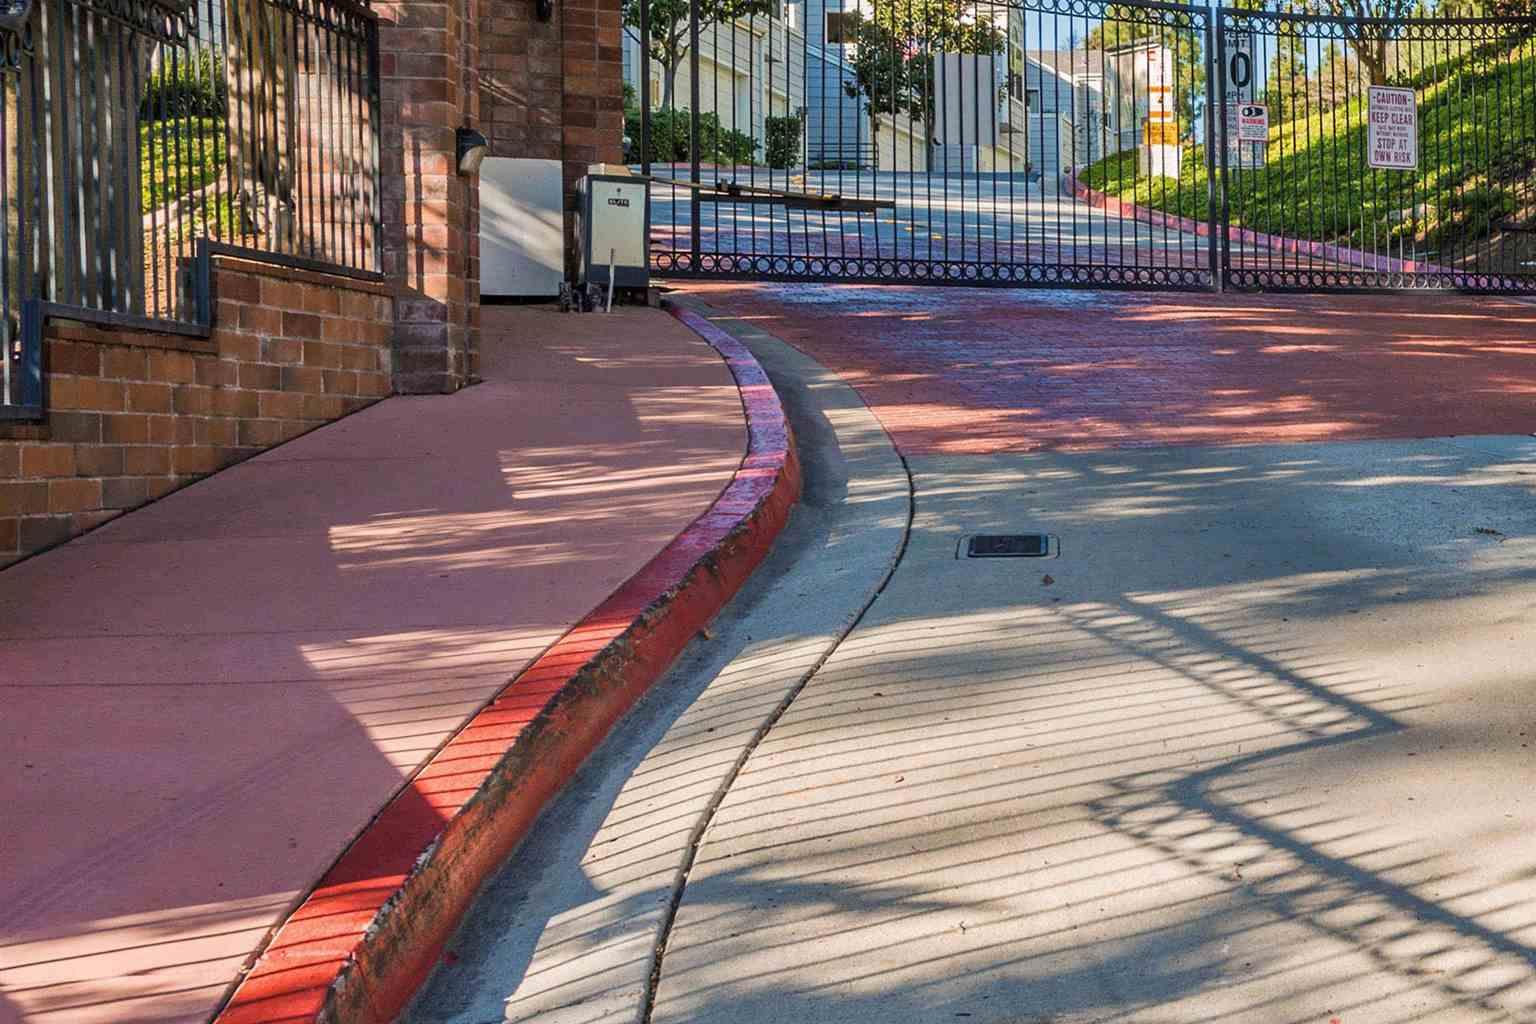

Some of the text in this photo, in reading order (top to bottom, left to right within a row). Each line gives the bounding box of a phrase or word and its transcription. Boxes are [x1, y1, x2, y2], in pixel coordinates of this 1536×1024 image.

[1230, 52, 1251, 88] 0
[1376, 92, 1407, 105] CAUTION
[1371, 112, 1413, 125] KEEP CLEAR
[1377, 137, 1408, 150] STOP AT
[1375, 150, 1411, 163] OWN RISK
